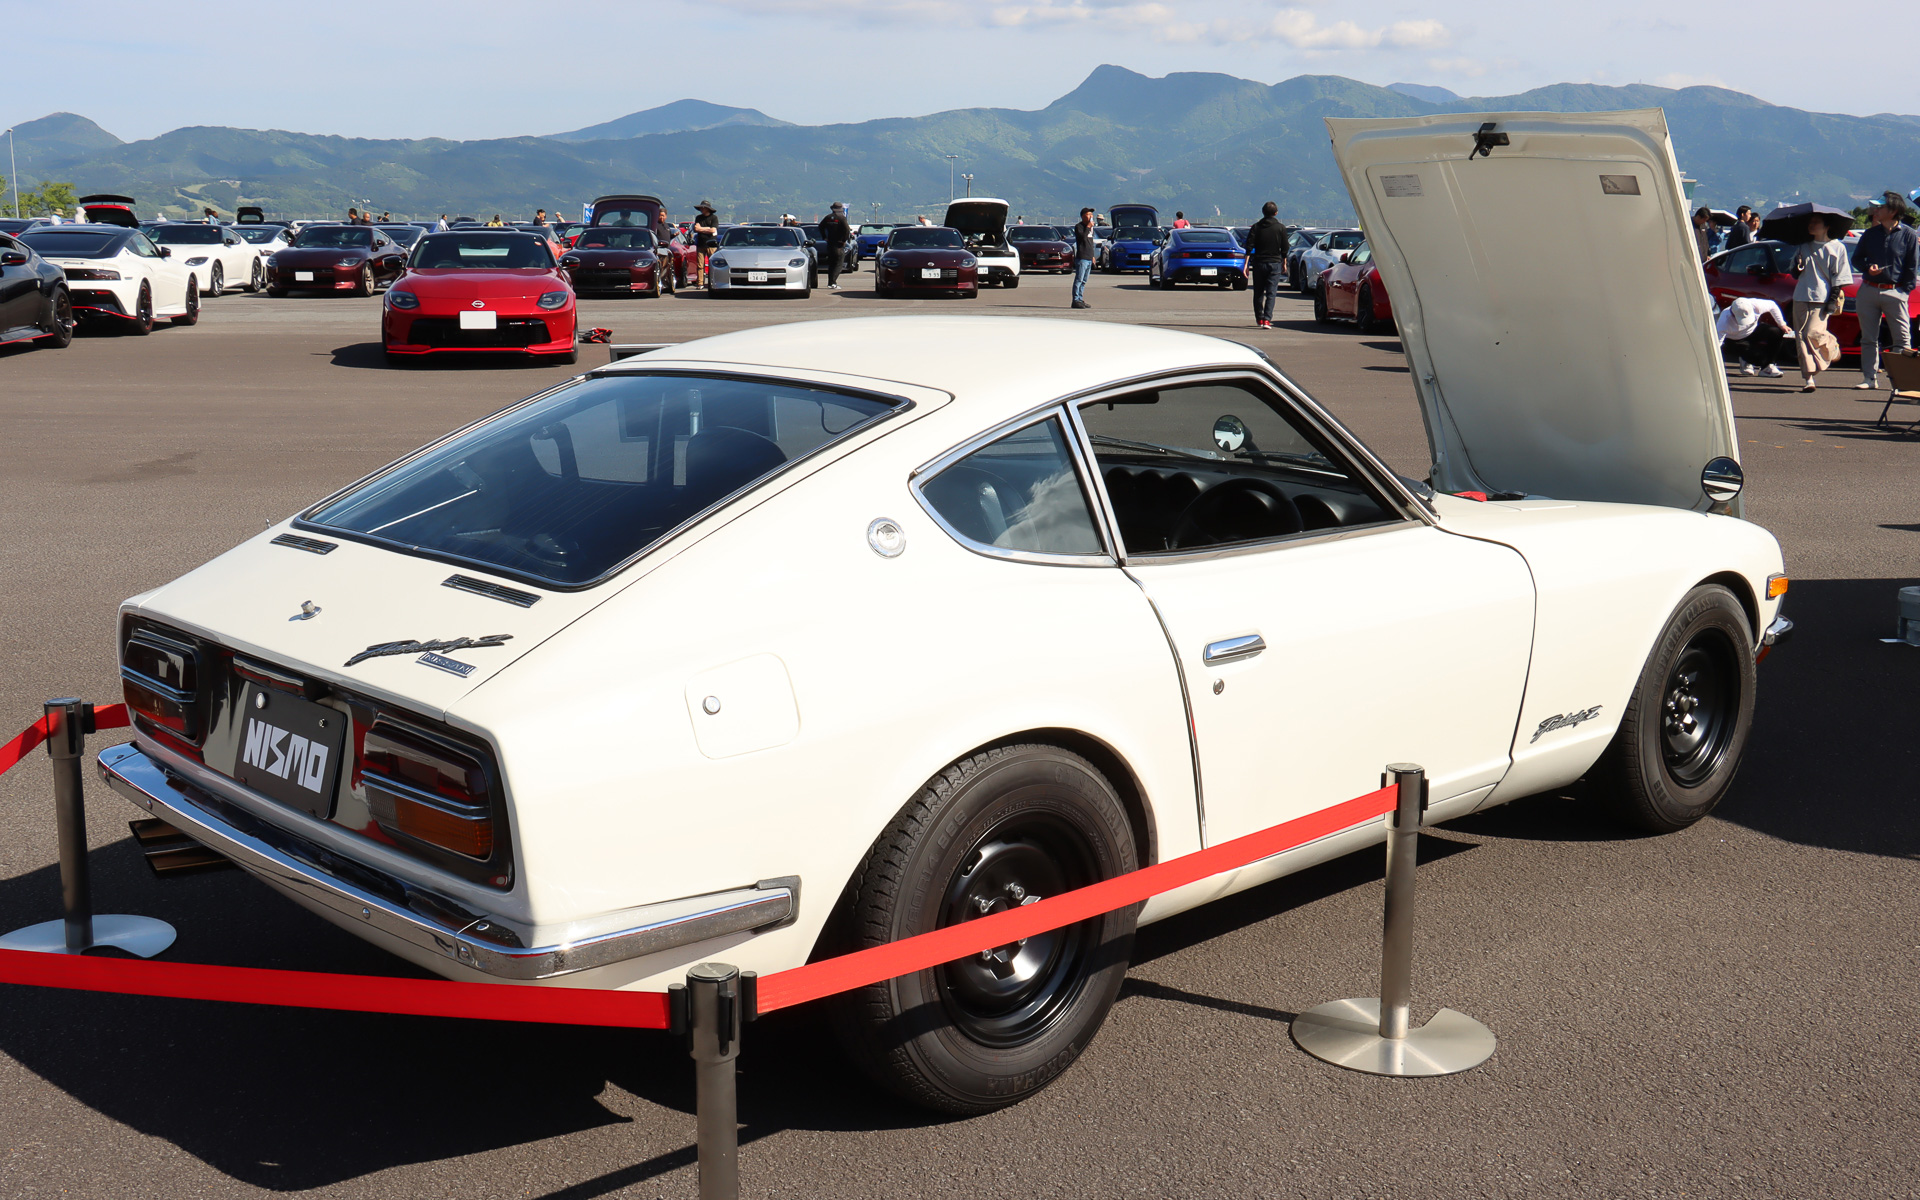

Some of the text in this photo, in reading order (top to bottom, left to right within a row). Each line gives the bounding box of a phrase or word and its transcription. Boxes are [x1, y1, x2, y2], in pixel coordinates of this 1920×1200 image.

[425, 651, 473, 674] NISSAN
[243, 717, 329, 794] NISMO
[985, 1042, 1079, 1096] YOKOHAMA
